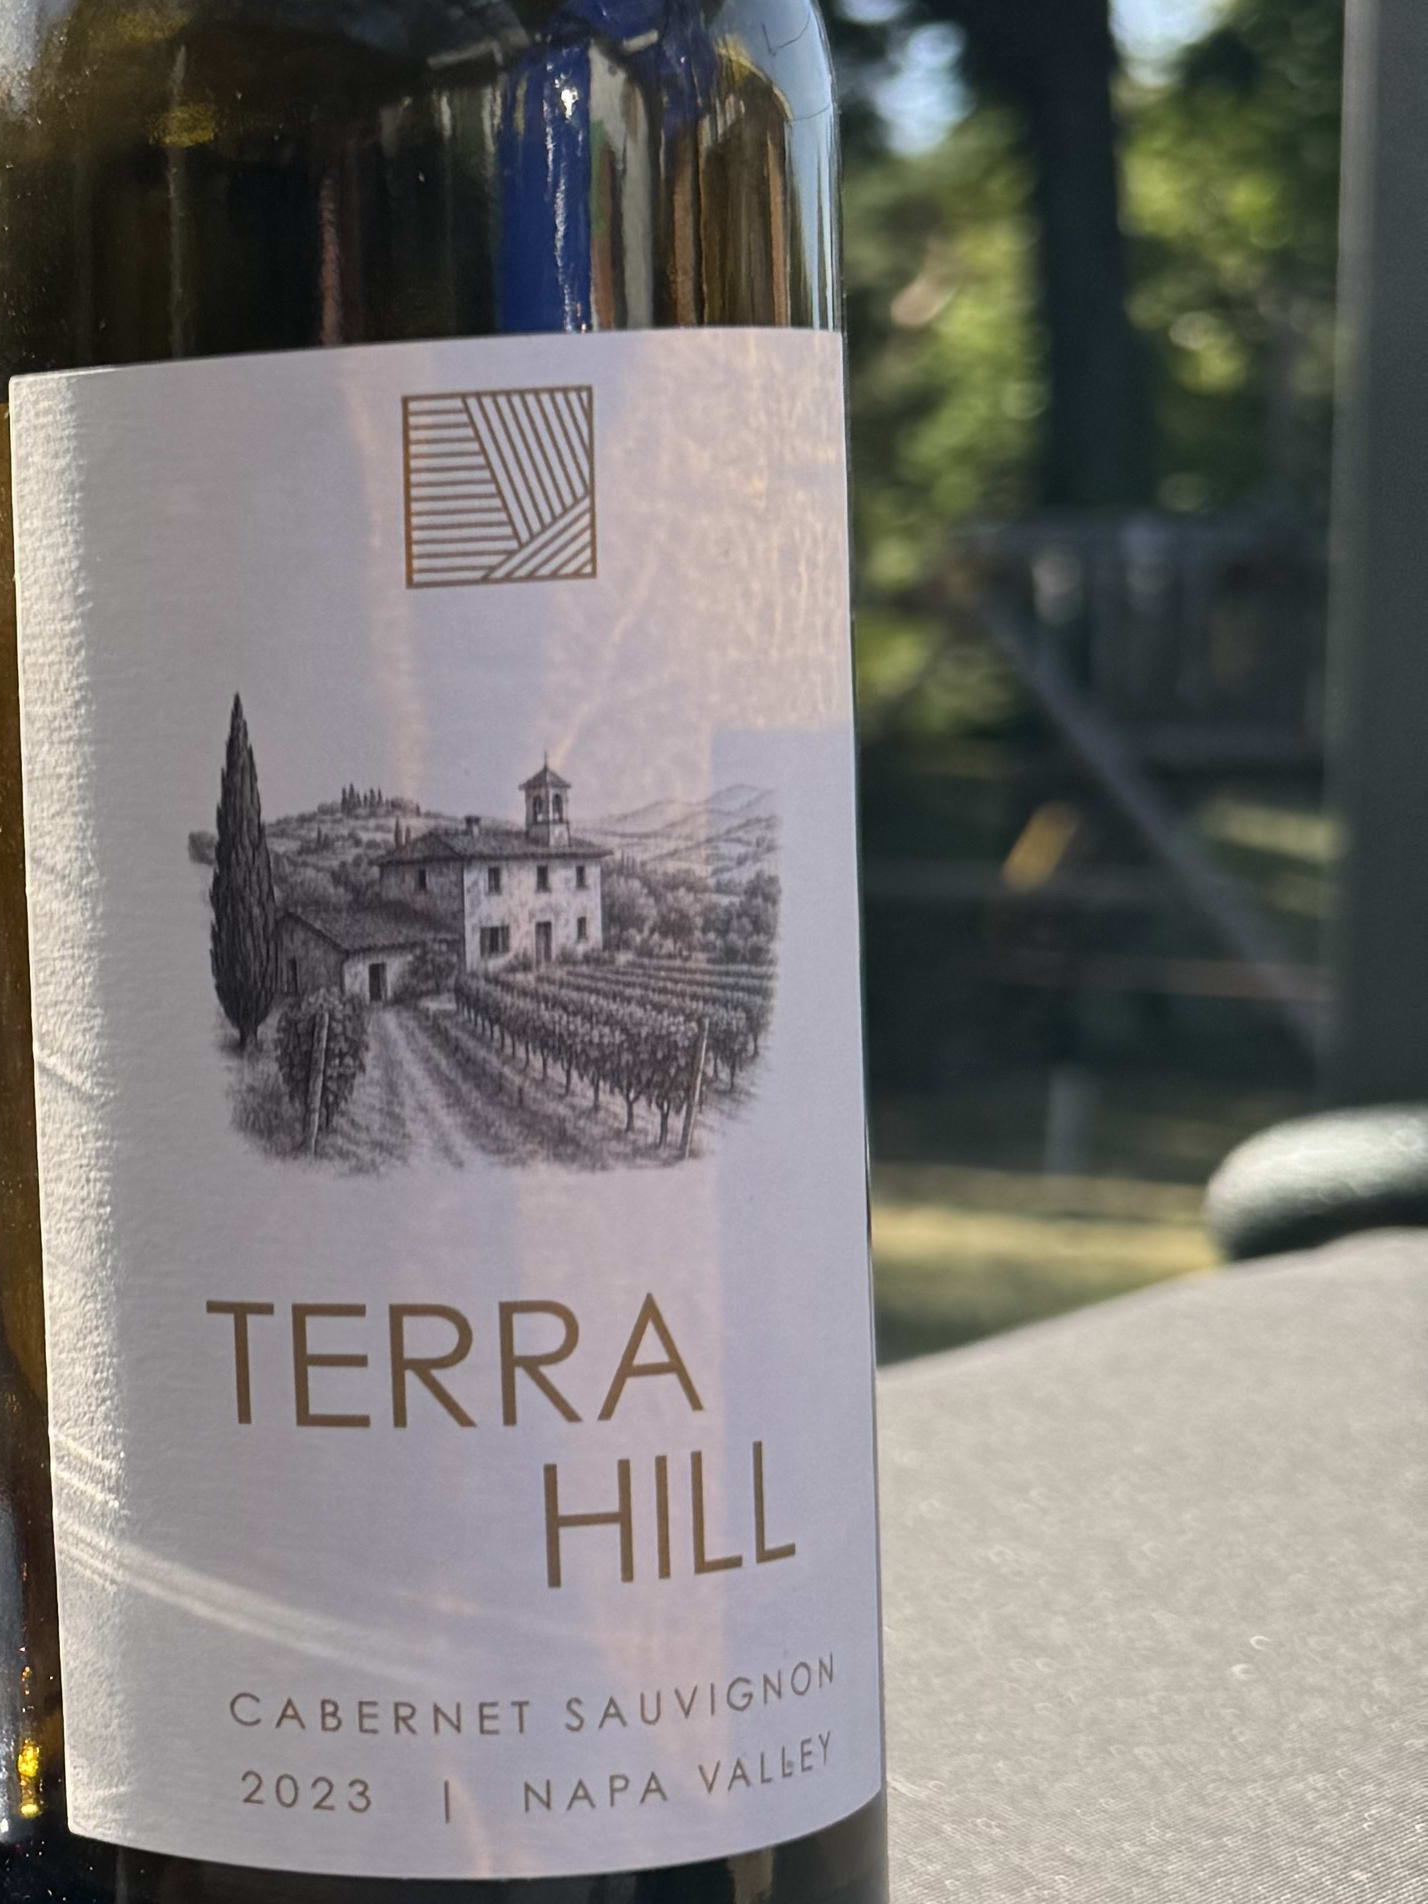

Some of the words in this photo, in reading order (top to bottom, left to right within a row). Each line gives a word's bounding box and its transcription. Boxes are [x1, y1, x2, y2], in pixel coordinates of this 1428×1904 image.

[205, 1292, 704, 1428] TERRA
[543, 1440, 796, 1589] HILL
[229, 1692, 530, 1735] CABERNET
[565, 1652, 835, 1732] SAUVIGNON
[241, 1770, 372, 1813] 2023
[523, 1771, 668, 1813] NAPA
[698, 1730, 832, 1794] VALLEY
